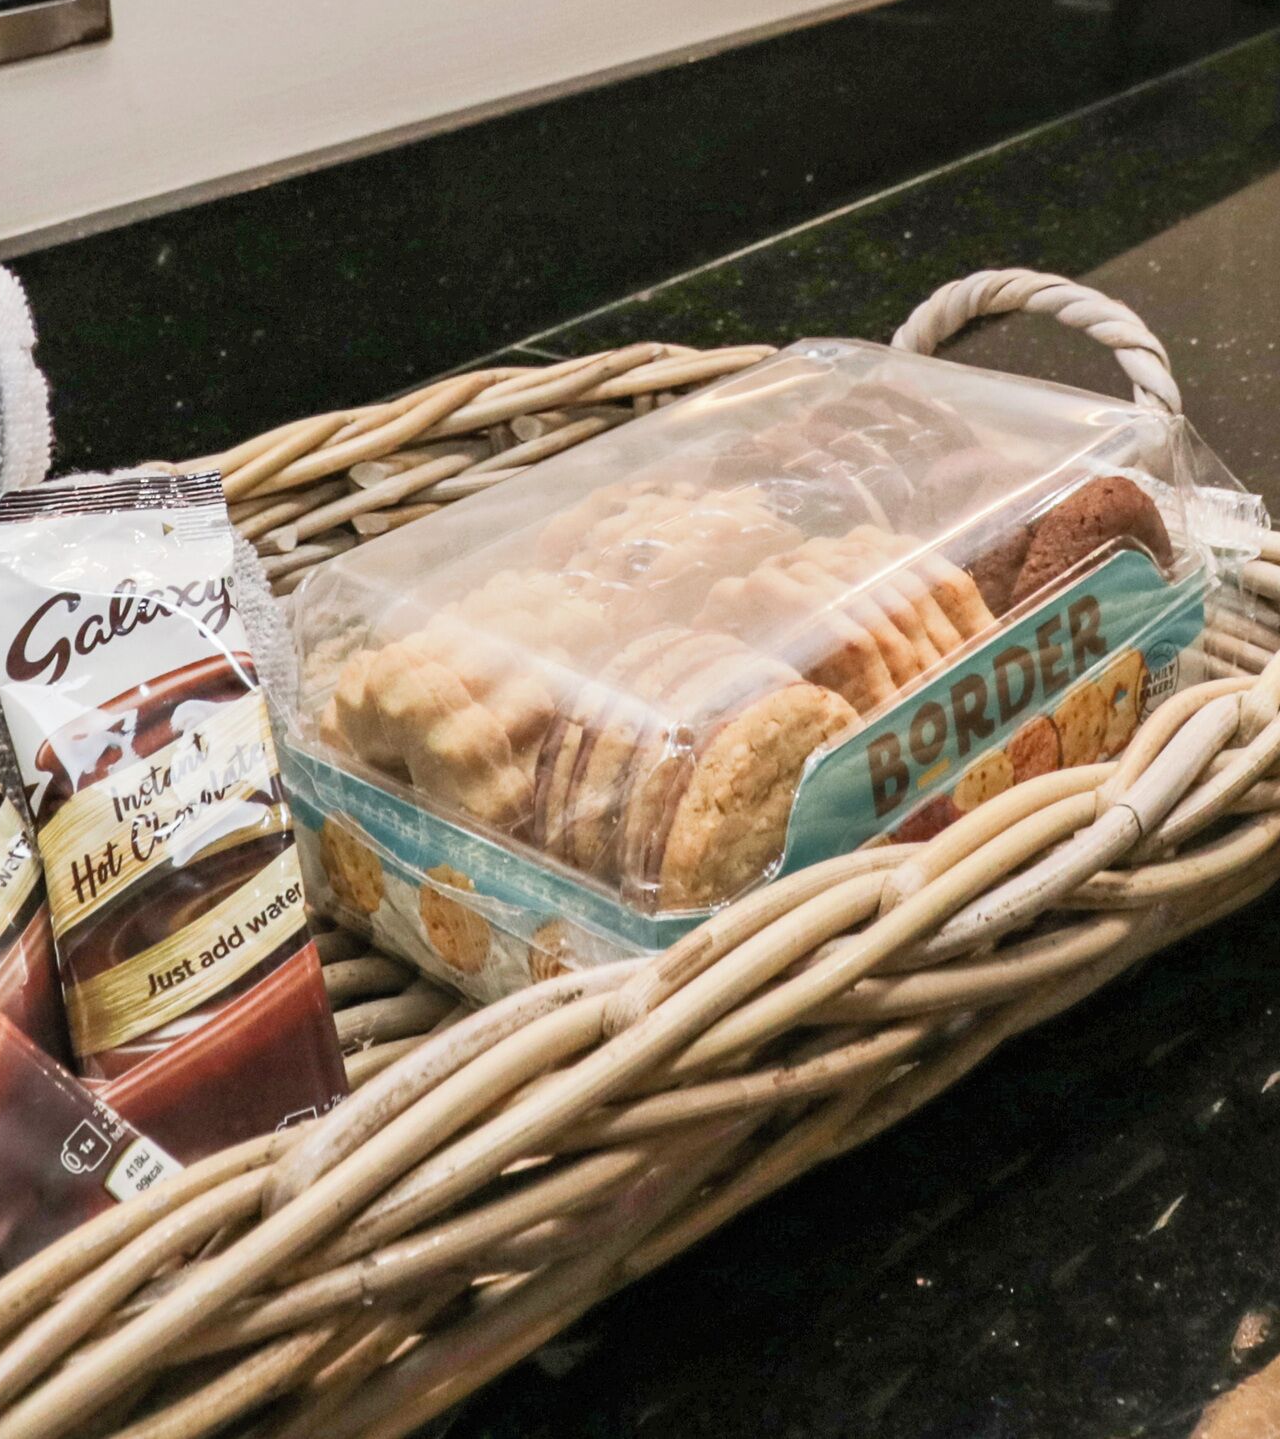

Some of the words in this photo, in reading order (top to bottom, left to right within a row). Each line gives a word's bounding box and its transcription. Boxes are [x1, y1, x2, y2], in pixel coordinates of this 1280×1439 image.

[5, 575, 241, 685] Galaxy
[866, 593, 1108, 820] BORDER
[70, 839, 124, 905] Hot
[130, 741, 267, 862] Chocolate
[110, 732, 210, 823] Instant
[147, 963, 195, 998] Just
[199, 924, 246, 969] add
[244, 880, 304, 936] water
